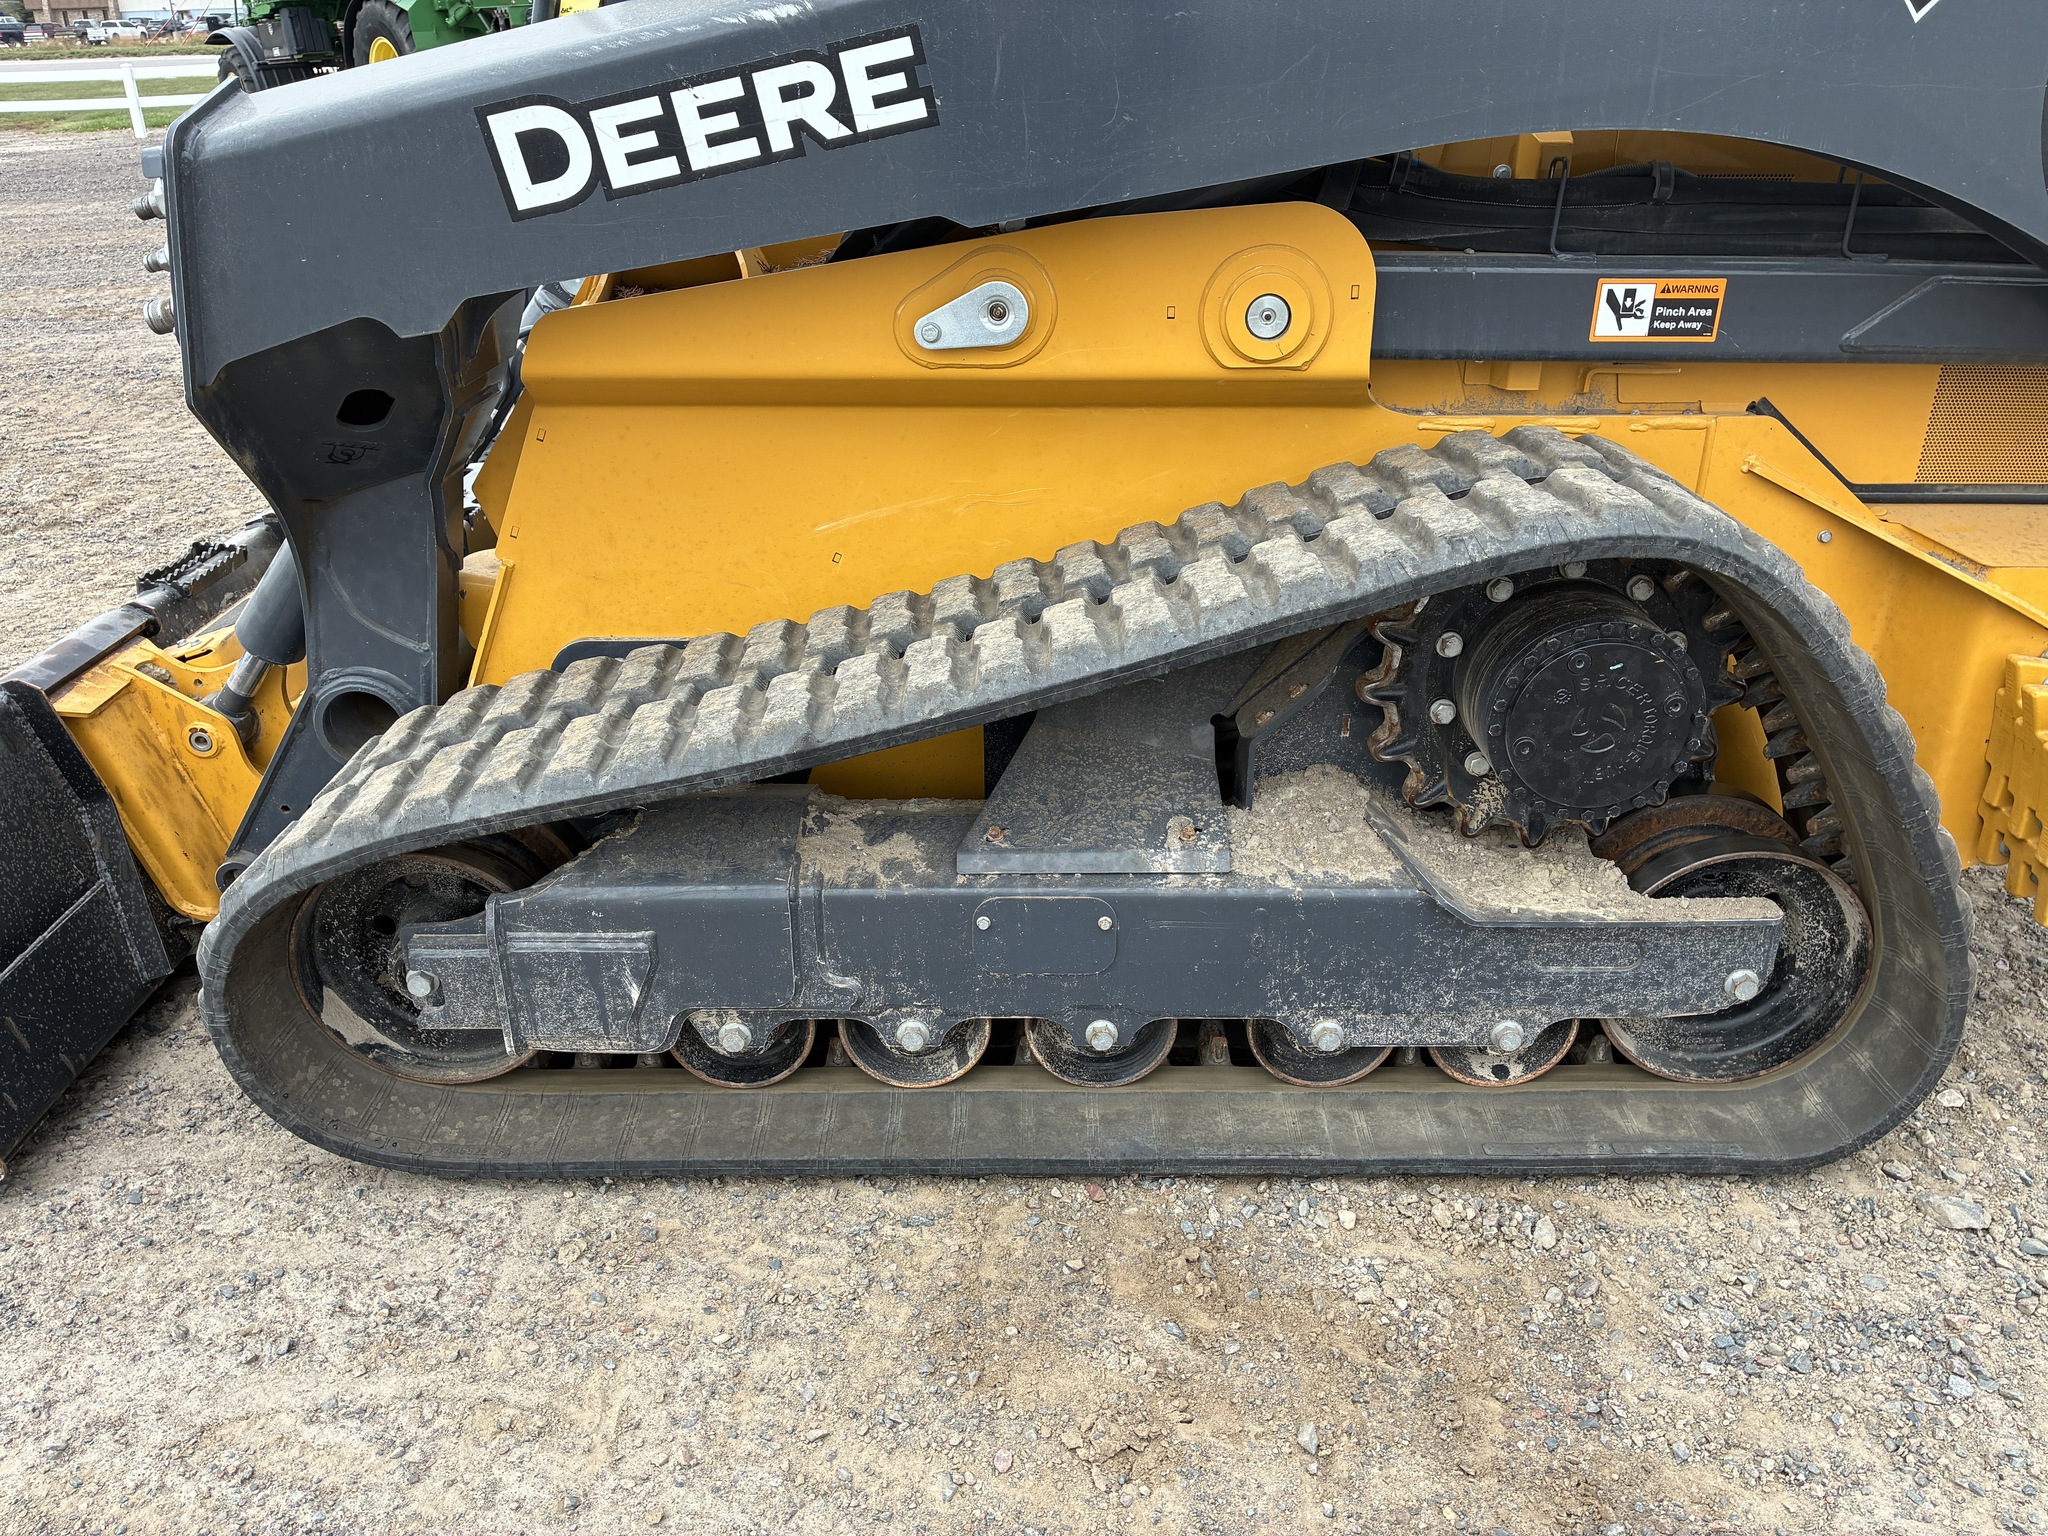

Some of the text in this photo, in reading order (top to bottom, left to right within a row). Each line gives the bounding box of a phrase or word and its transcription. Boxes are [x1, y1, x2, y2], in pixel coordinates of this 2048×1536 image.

[486, 35, 928, 211] DEERE
[1671, 284, 1719, 294] WARNING
[1655, 306, 1713, 317] Pinch Area
[1653, 320, 1703, 330] Keep Away
[1579, 672, 1654, 706] SPICER
